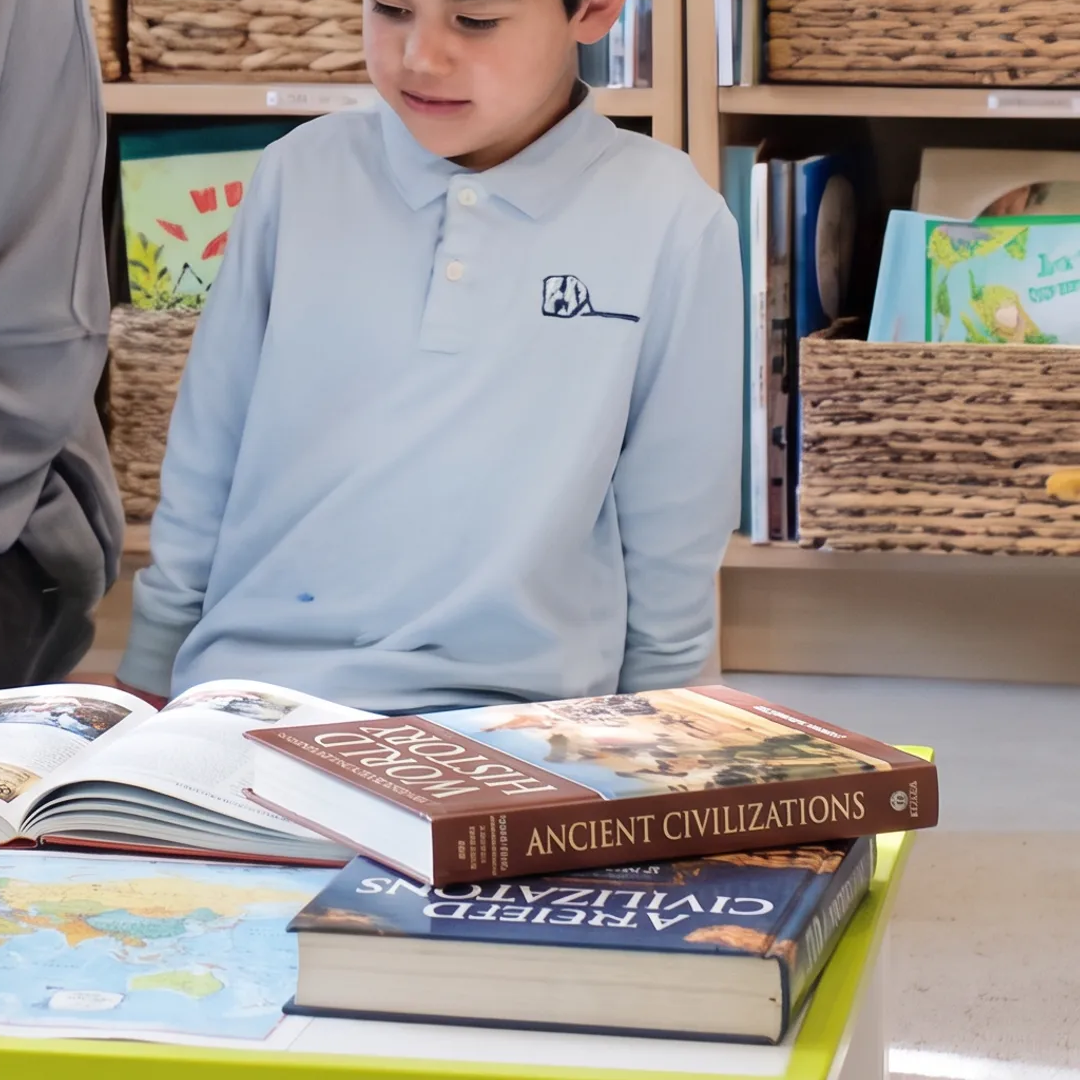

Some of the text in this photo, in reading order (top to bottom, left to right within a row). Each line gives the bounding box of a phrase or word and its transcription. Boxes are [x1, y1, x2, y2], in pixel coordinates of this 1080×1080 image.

[314, 732, 481, 799] WORLD
[358, 724, 559, 797] HISTORY
[525, 815, 655, 857] ANCIENT
[663, 791, 866, 841] CIVILIZATIONS
